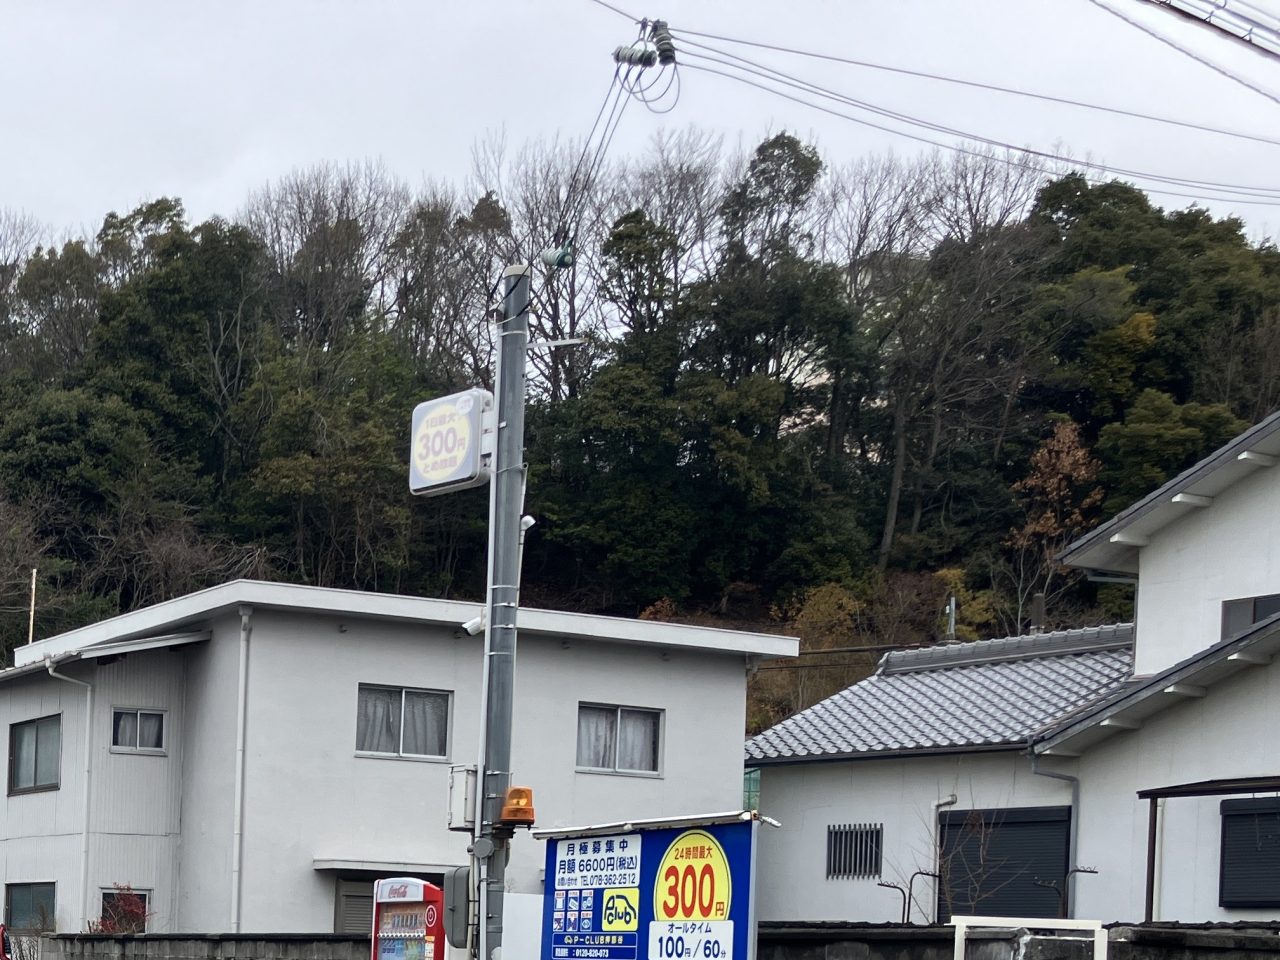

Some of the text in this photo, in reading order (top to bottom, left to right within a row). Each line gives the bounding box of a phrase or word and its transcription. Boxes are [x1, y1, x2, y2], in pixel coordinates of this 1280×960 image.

[567, 838, 628, 856] 月極募集中
[674, 845, 713, 860] 24時間最大
[662, 863, 725, 918] 300円
[667, 922, 712, 934] オールタイム
